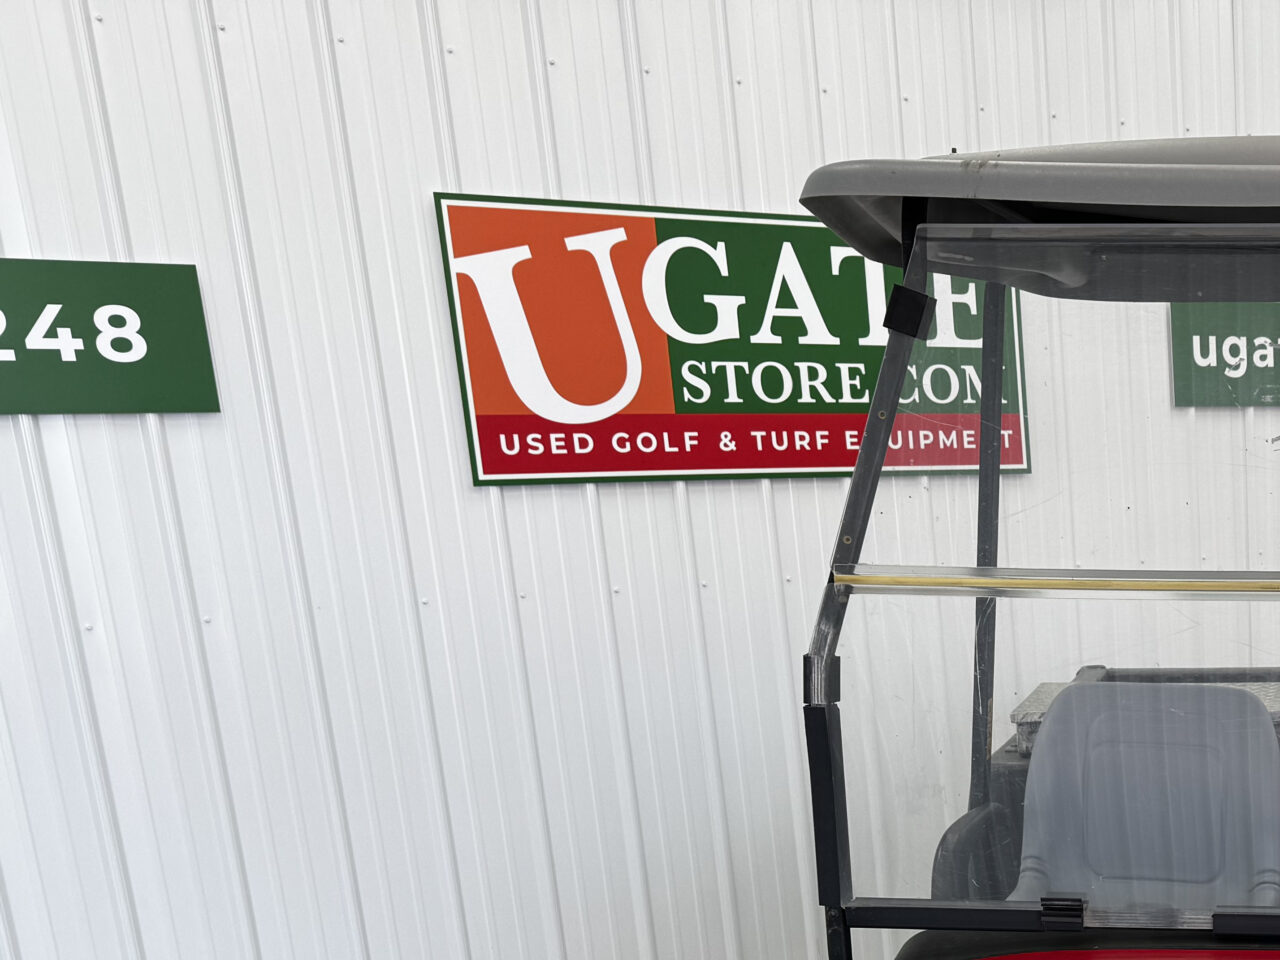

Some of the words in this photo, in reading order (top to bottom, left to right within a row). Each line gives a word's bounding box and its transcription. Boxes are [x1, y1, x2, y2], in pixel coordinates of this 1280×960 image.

[499, 432, 595, 456] USED
[611, 431, 699, 453] GOLF
[719, 430, 737, 452] &
[751, 430, 830, 451] TURF
[844, 430, 1013, 450] EUIPMET
